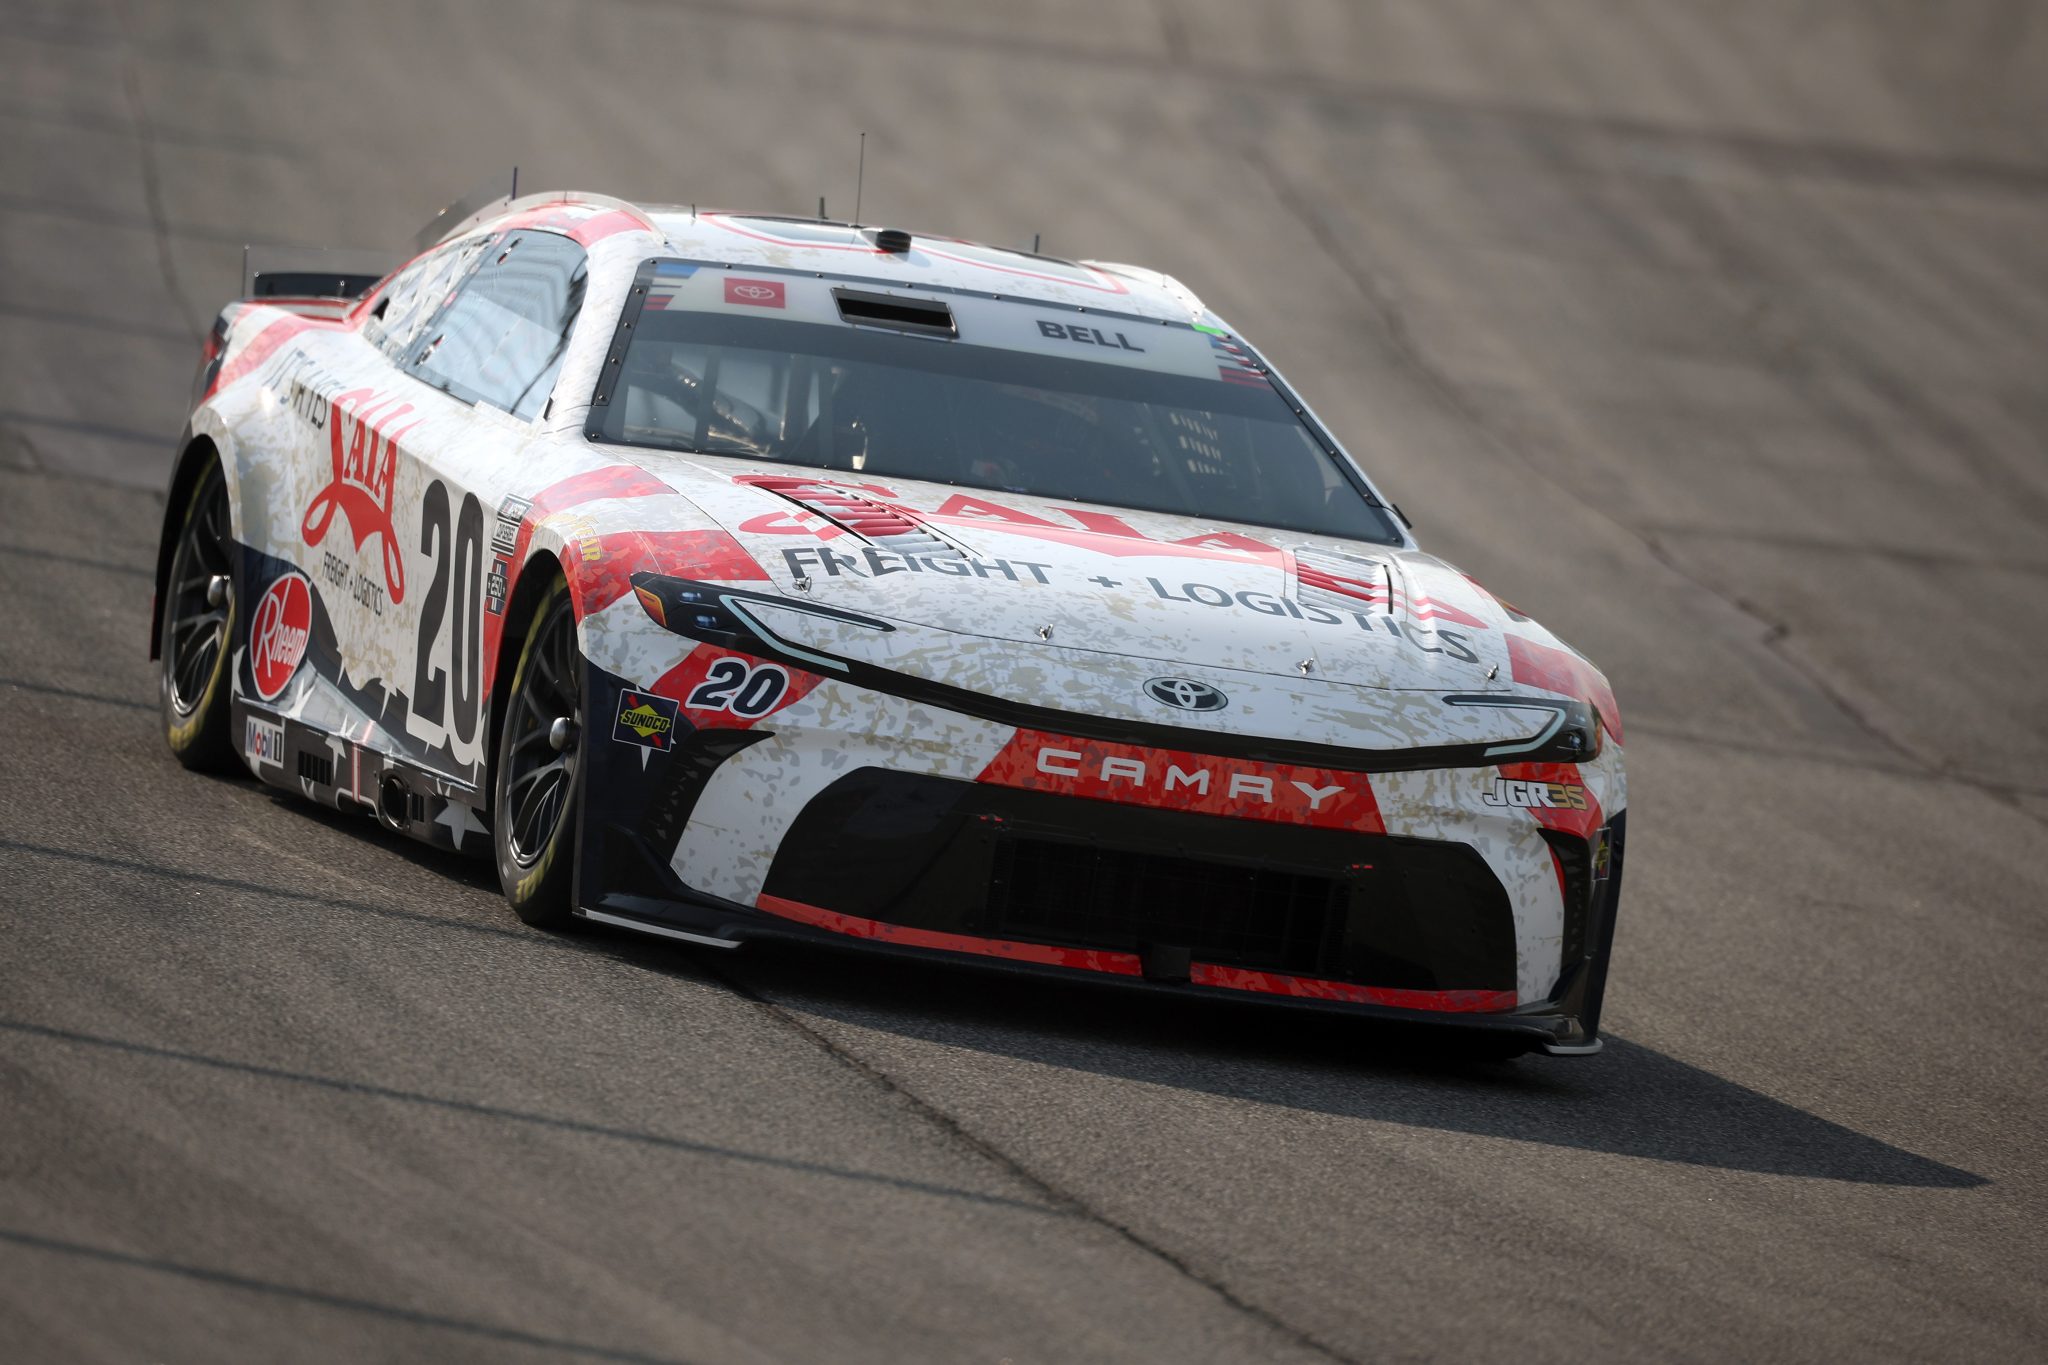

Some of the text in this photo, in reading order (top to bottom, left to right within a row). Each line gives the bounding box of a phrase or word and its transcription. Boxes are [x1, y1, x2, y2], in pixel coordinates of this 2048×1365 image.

[1036, 320, 1146, 353] BELL
[322, 551, 349, 592] FREIGHT
[353, 572, 384, 616] LOGISTICS
[412, 479, 485, 746] 20
[781, 547, 1053, 586] FREIGHT
[1146, 576, 1480, 664] LOGISTICS
[255, 577, 307, 679] Rheem
[686, 657, 789, 718] 20
[247, 721, 273, 760] Mobil
[622, 710, 670, 732] SUNOCO
[1036, 747, 1346, 810] CAMRY
